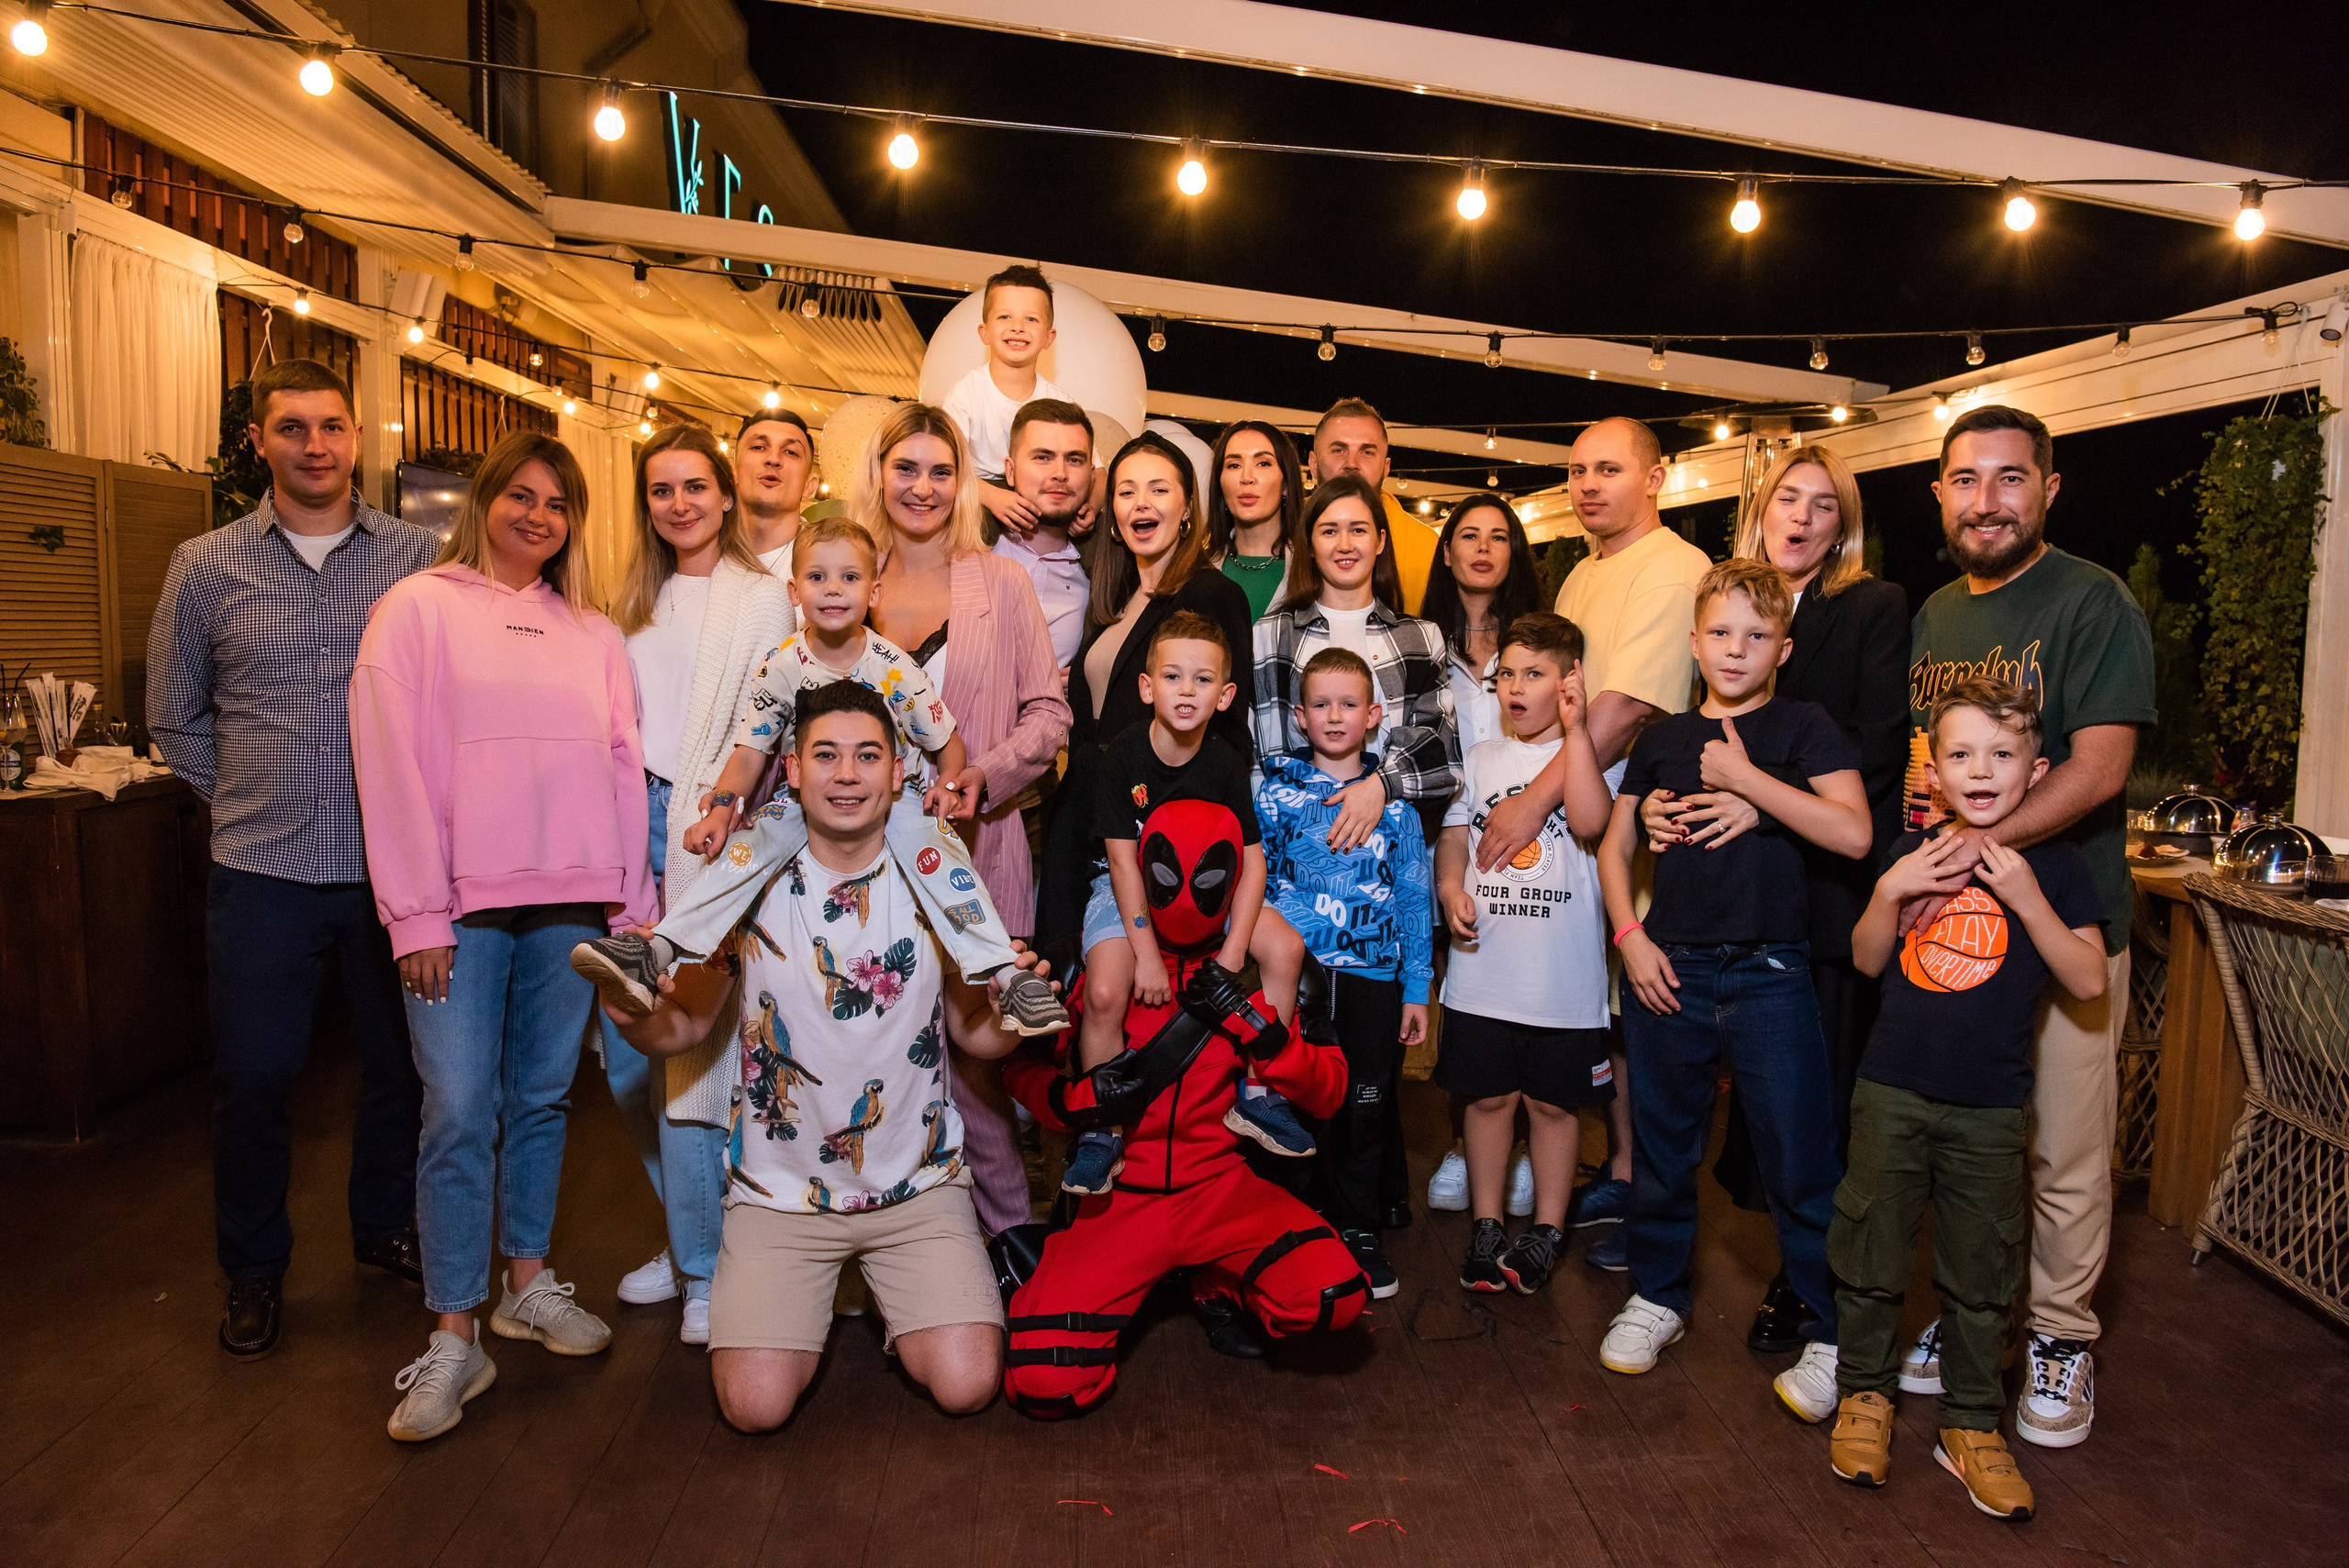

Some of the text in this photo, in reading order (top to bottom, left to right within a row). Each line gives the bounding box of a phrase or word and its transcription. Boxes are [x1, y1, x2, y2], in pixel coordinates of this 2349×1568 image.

[733, 848, 748, 861] WE
[918, 851, 940, 872] FUN
[951, 874, 975, 888] VIBE
[1475, 884, 1572, 904] FOUR GROUP
[1938, 888, 1991, 918] ASS
[1314, 893, 1347, 929] DO
[1489, 902, 1551, 918] WINNER
[1933, 915, 2001, 957] PLAY
[1920, 944, 1998, 988] OVERTIME
